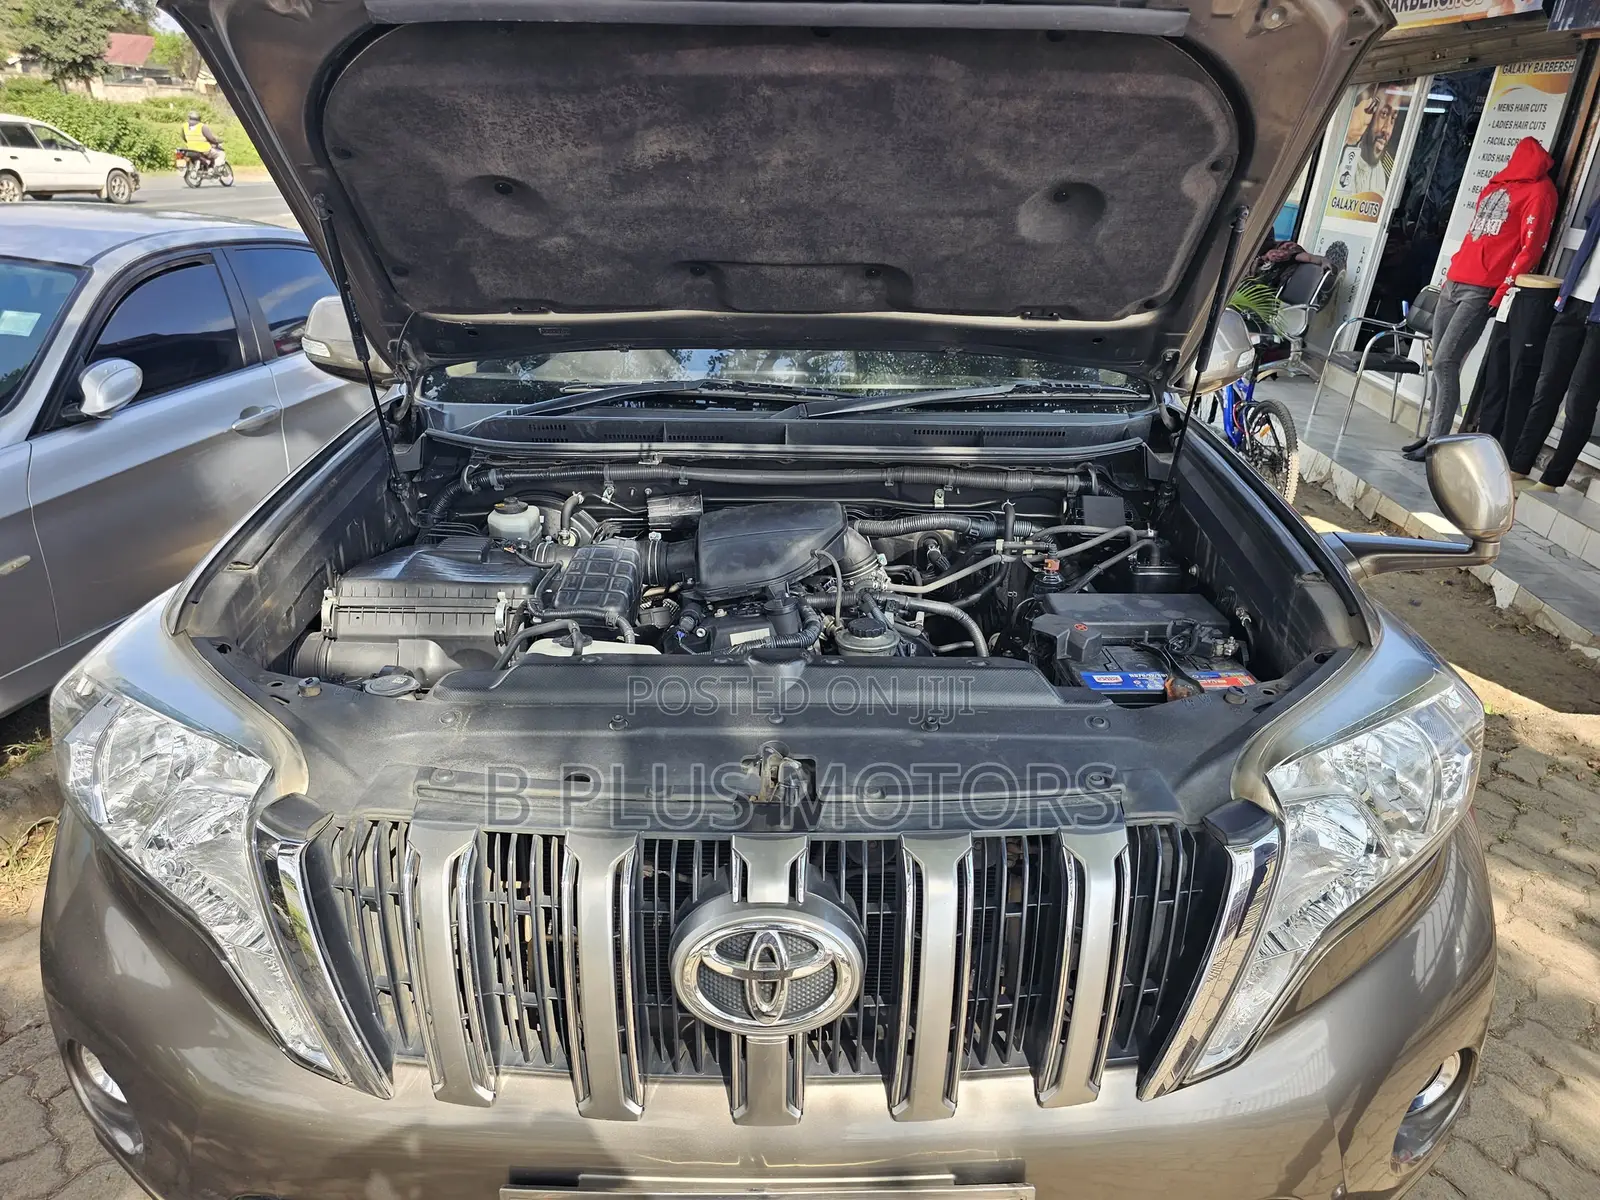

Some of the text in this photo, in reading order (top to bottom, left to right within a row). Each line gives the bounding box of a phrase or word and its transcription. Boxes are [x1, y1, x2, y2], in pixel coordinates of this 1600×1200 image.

[1502, 61, 1575, 74] GALAXY BARBERSH
[1497, 103, 1515, 113] MENS
[1514, 103, 1530, 113] HAIR
[1530, 103, 1548, 113] CUTS
[1491, 120, 1546, 131] LADIES HAIR CUTS
[1486, 136, 1506, 147] FACIAL
[1481, 154, 1495, 162] KIDS
[1476, 171, 1493, 179] HEAD
[1331, 197, 1379, 216] GALAXY CUTS
